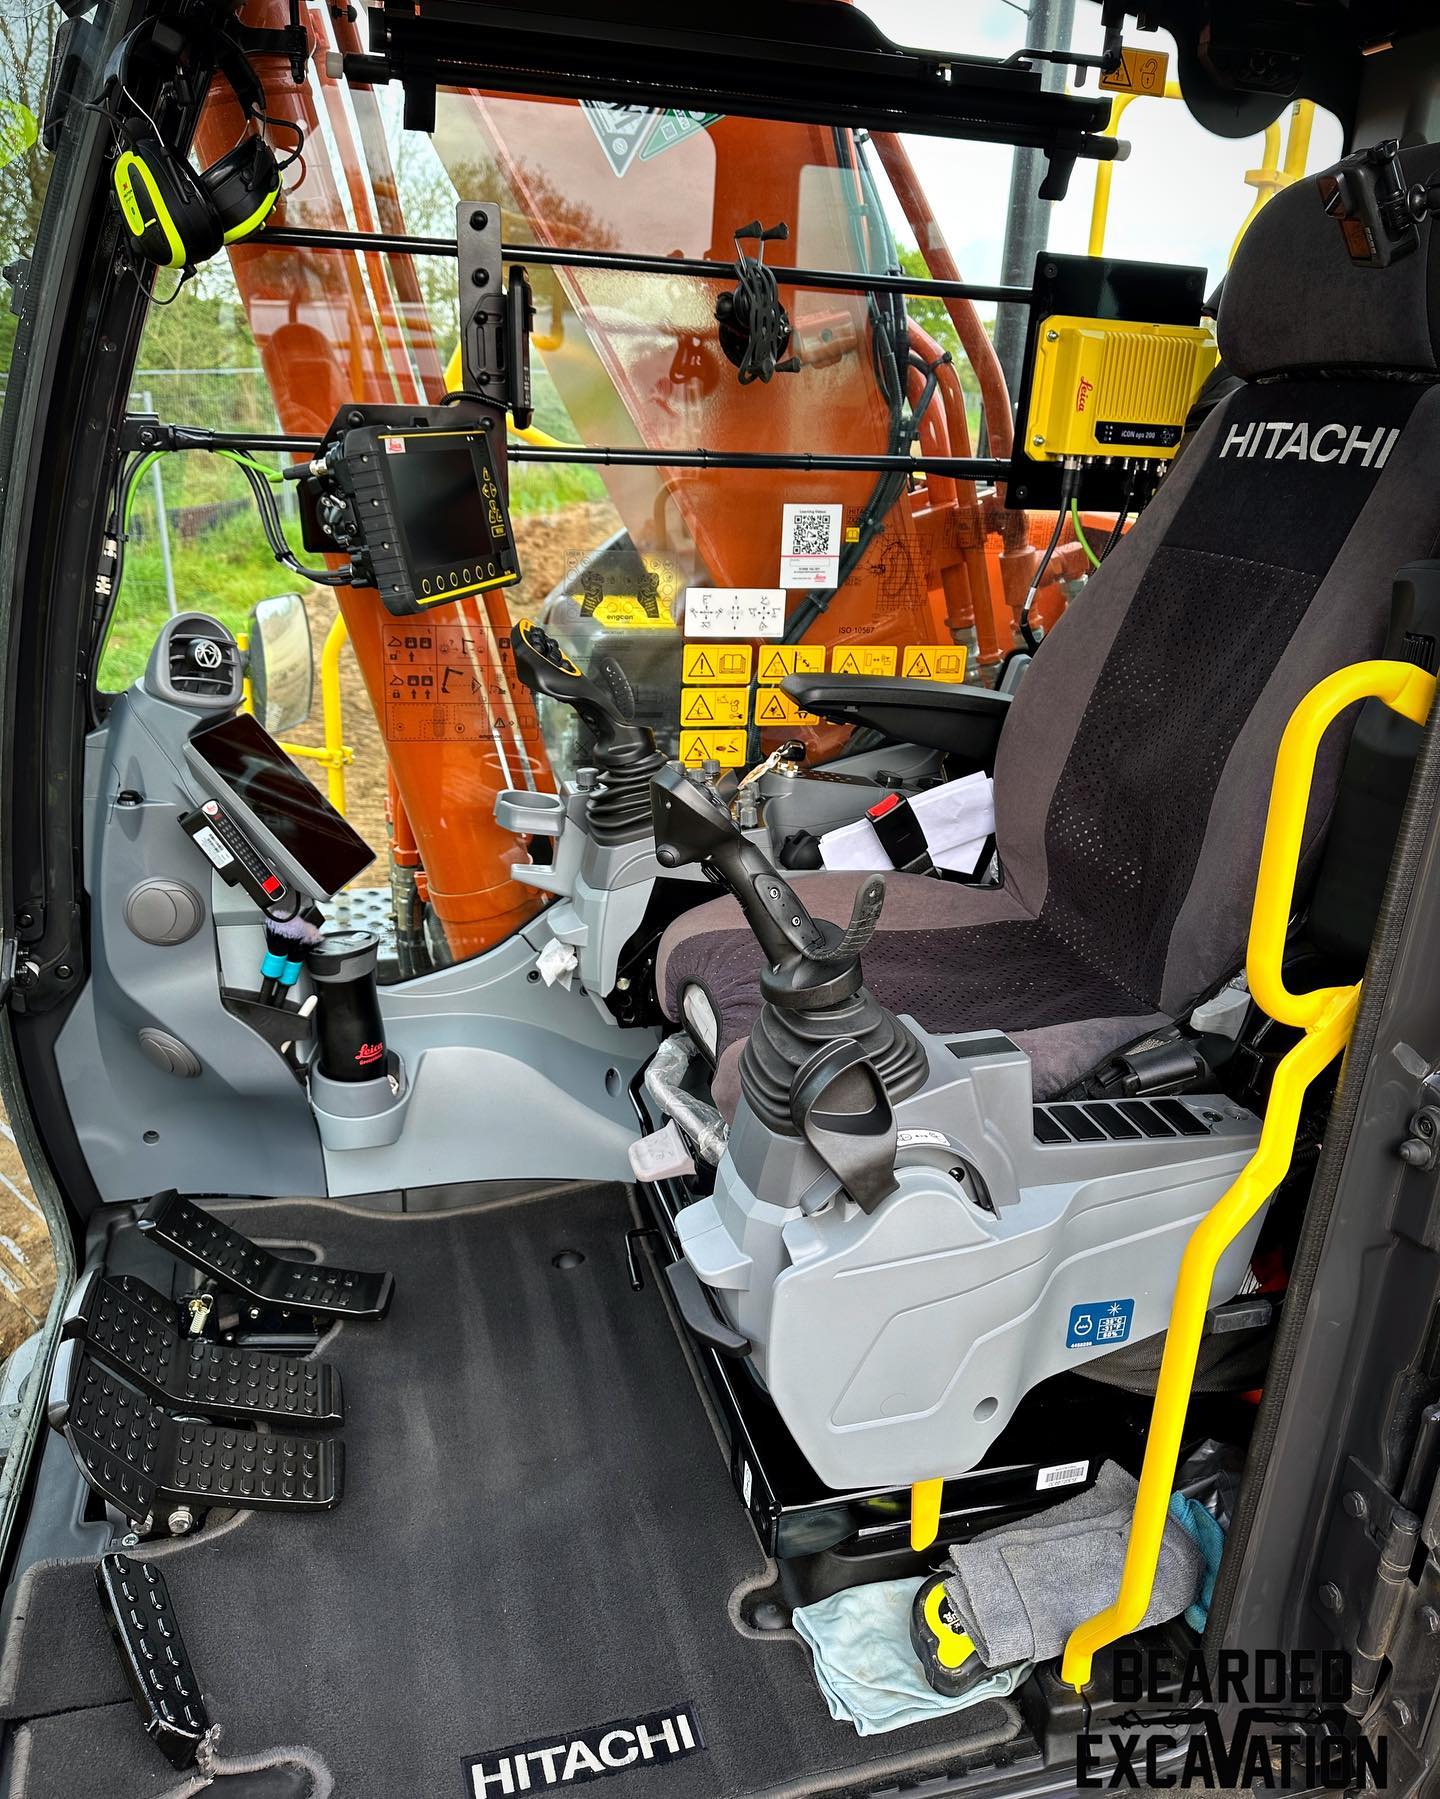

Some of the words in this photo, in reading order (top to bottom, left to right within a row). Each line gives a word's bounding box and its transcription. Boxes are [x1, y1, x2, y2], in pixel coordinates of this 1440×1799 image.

[1076, 376, 1093, 412] Leica
[1220, 422, 1401, 468] HITACHI
[606, 614, 634, 622] engcon
[838, 626, 852, 634] ISO
[854, 626, 875, 634] 10567
[355, 1042, 383, 1060] Leica
[472, 1714, 696, 1799] HITACHI
